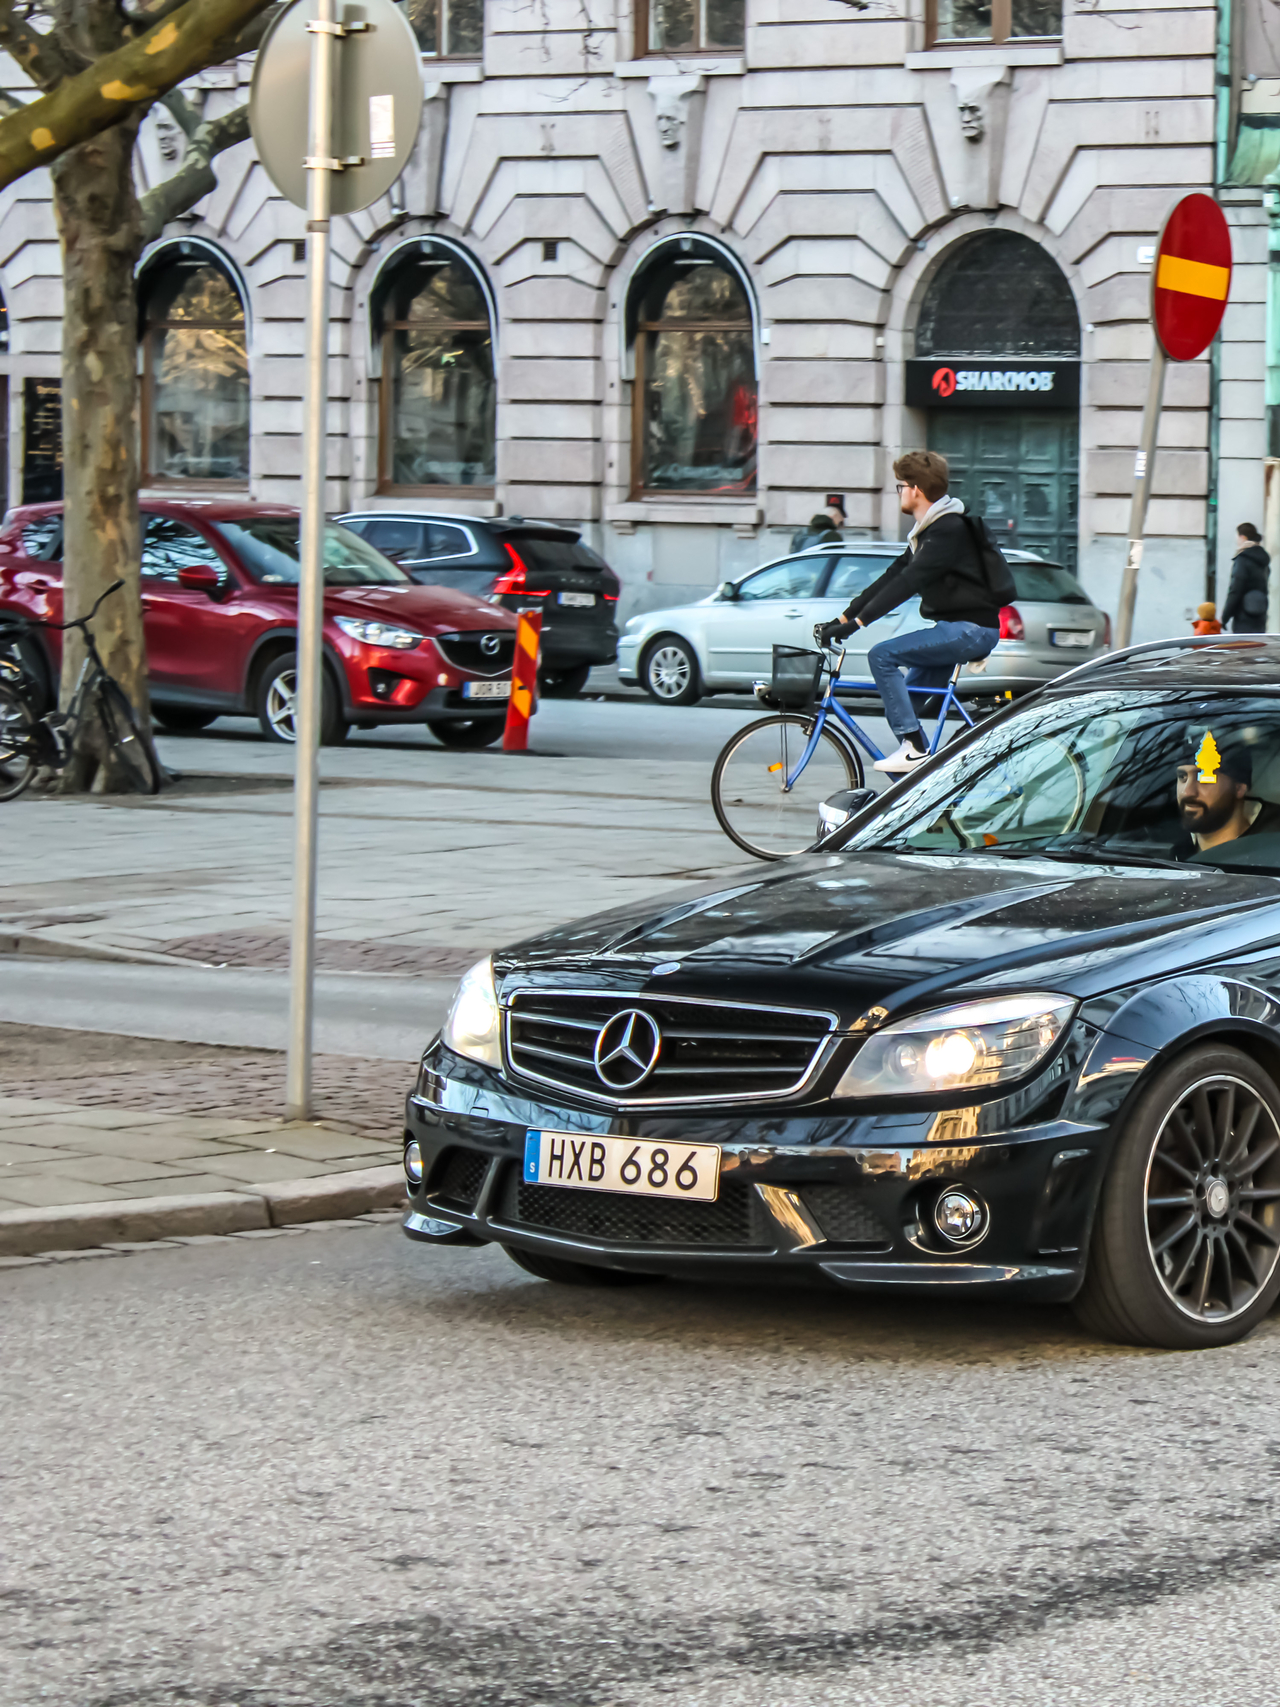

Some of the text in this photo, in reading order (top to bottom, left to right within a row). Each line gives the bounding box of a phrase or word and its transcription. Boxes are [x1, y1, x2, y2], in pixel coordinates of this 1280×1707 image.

[955, 371, 1054, 391] SHARKMOB
[529, 1162, 536, 1173] S
[548, 1138, 698, 1191] HXB 686
